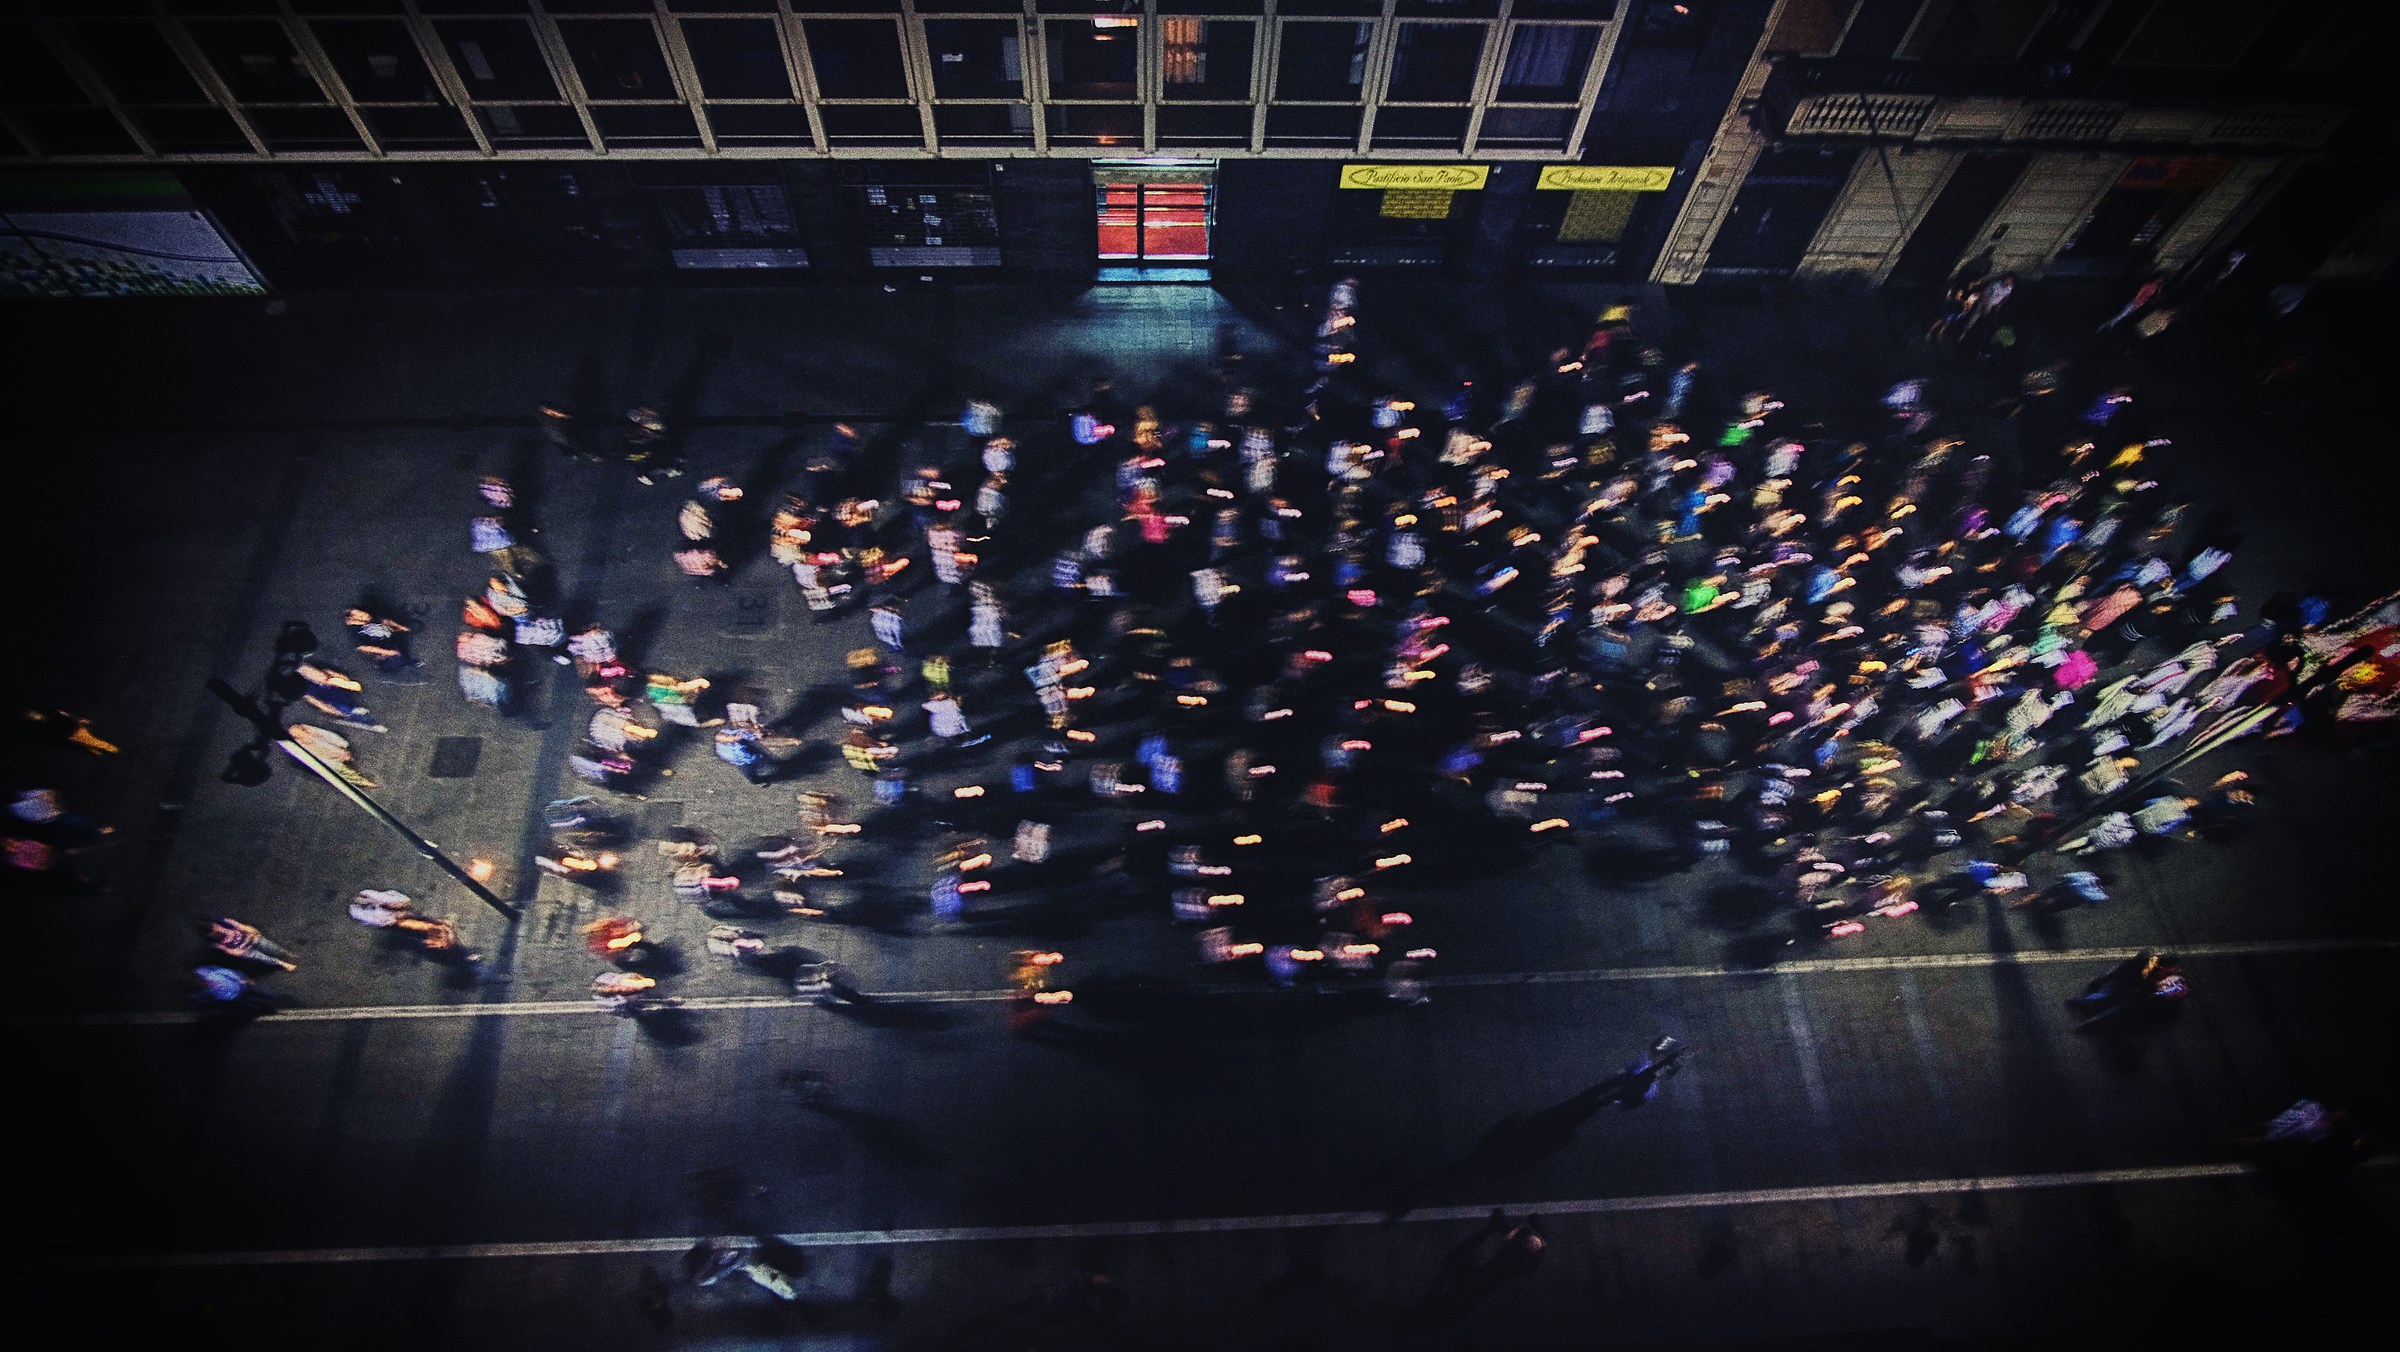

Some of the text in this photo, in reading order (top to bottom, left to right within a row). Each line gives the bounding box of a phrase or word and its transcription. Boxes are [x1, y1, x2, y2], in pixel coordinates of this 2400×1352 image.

[1365, 168, 1464, 188] Pastificio San Paolo
